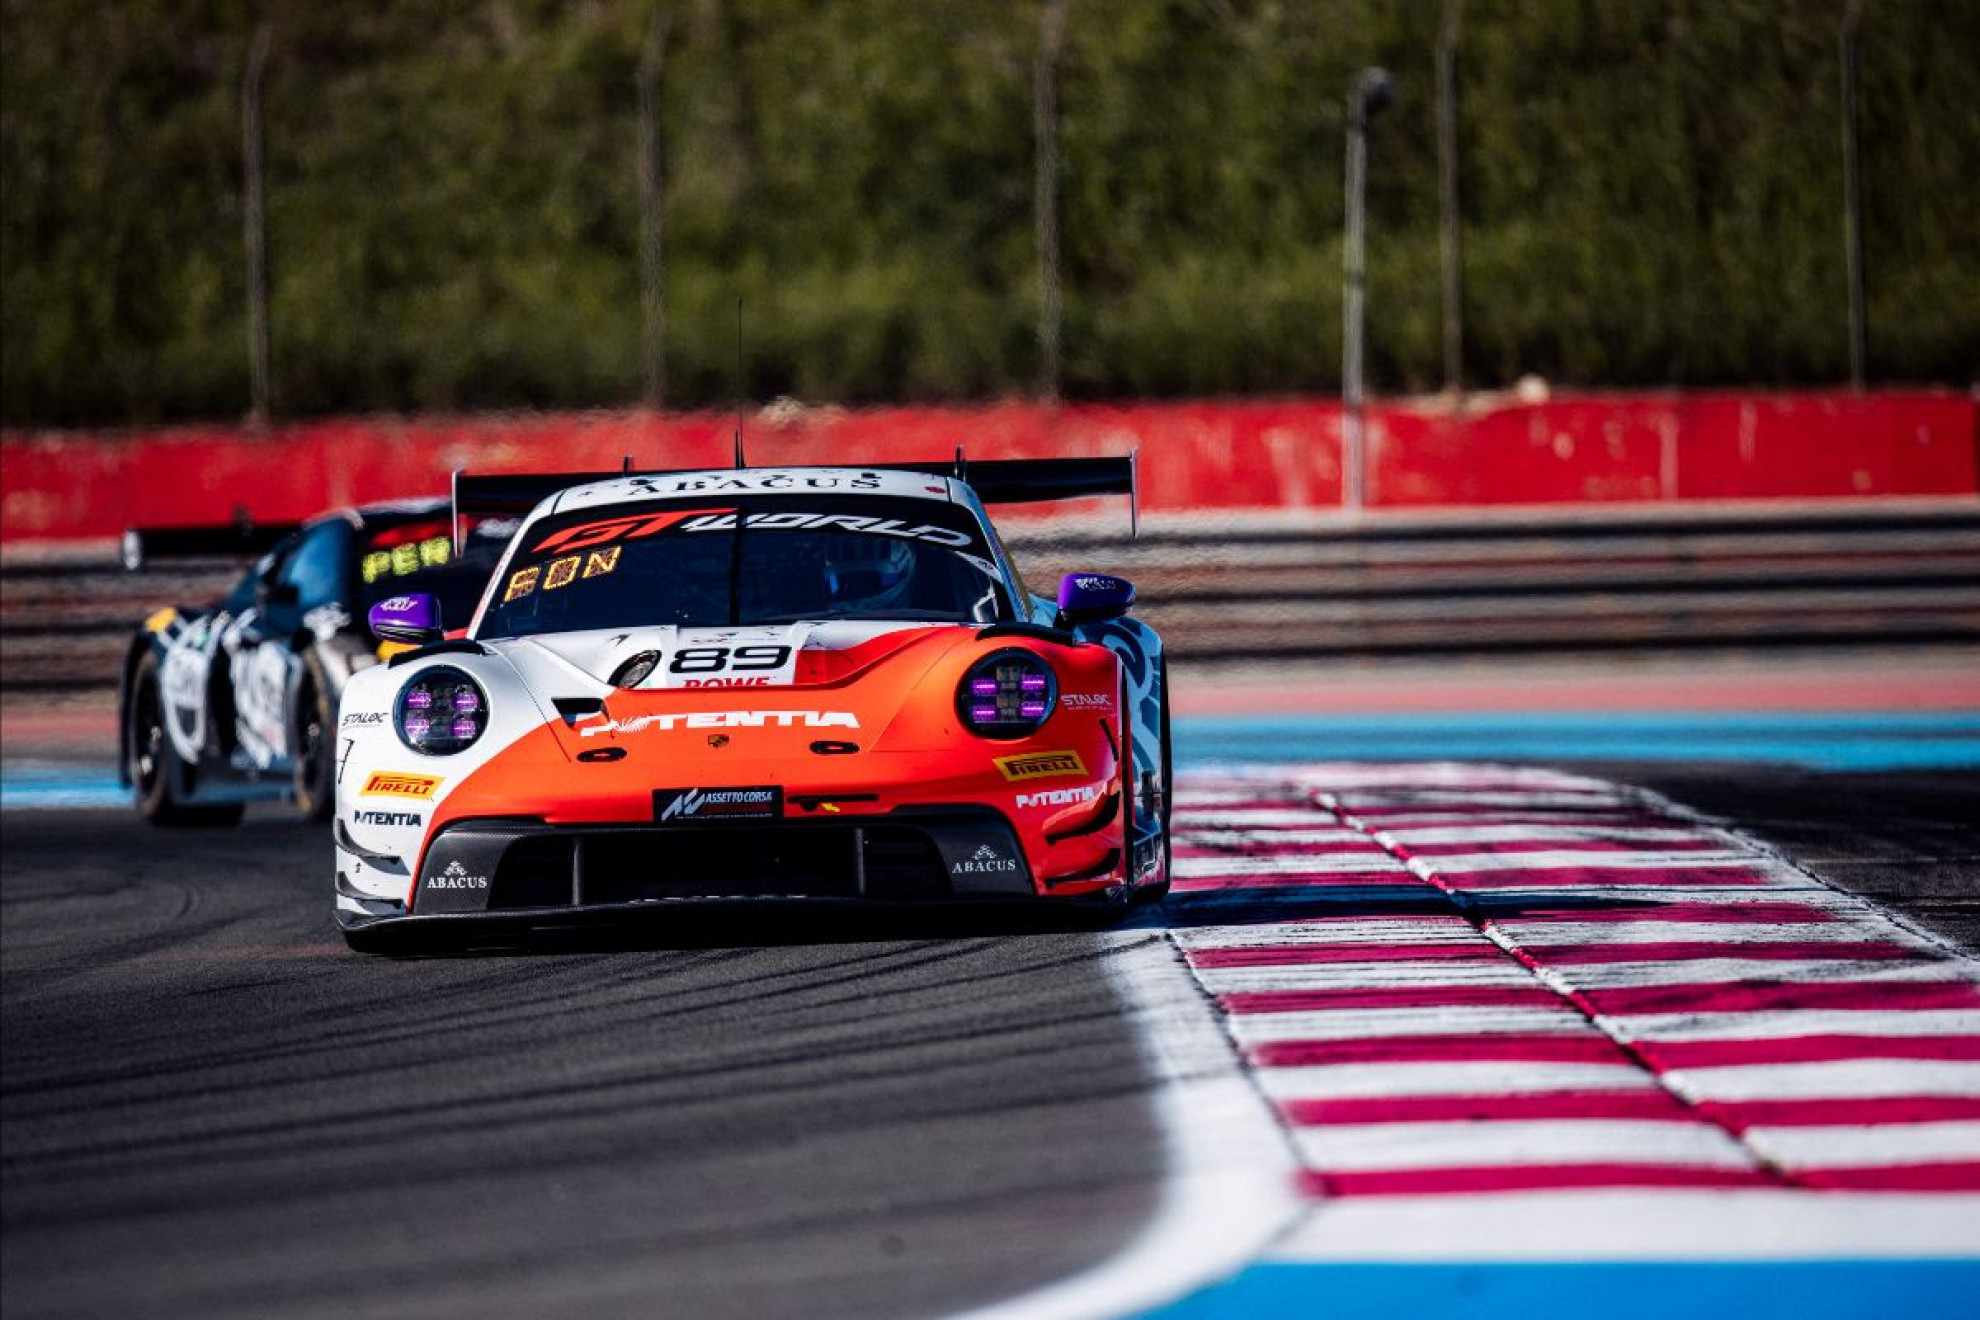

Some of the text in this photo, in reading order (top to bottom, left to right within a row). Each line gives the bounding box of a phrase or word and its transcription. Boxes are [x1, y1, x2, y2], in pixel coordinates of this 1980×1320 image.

[627, 473, 882, 496] ABACUS
[531, 508, 738, 554] GT
[680, 513, 972, 547] WORLD
[504, 545, 622, 602] FON
[669, 645, 793, 674] 89
[1004, 755, 1080, 776] PIRELLI
[366, 775, 435, 795] PIRELLI
[705, 791, 773, 803] ASSETTO CORSA
[951, 858, 1016, 874] ABACUS
[426, 876, 488, 889] ABACUS
